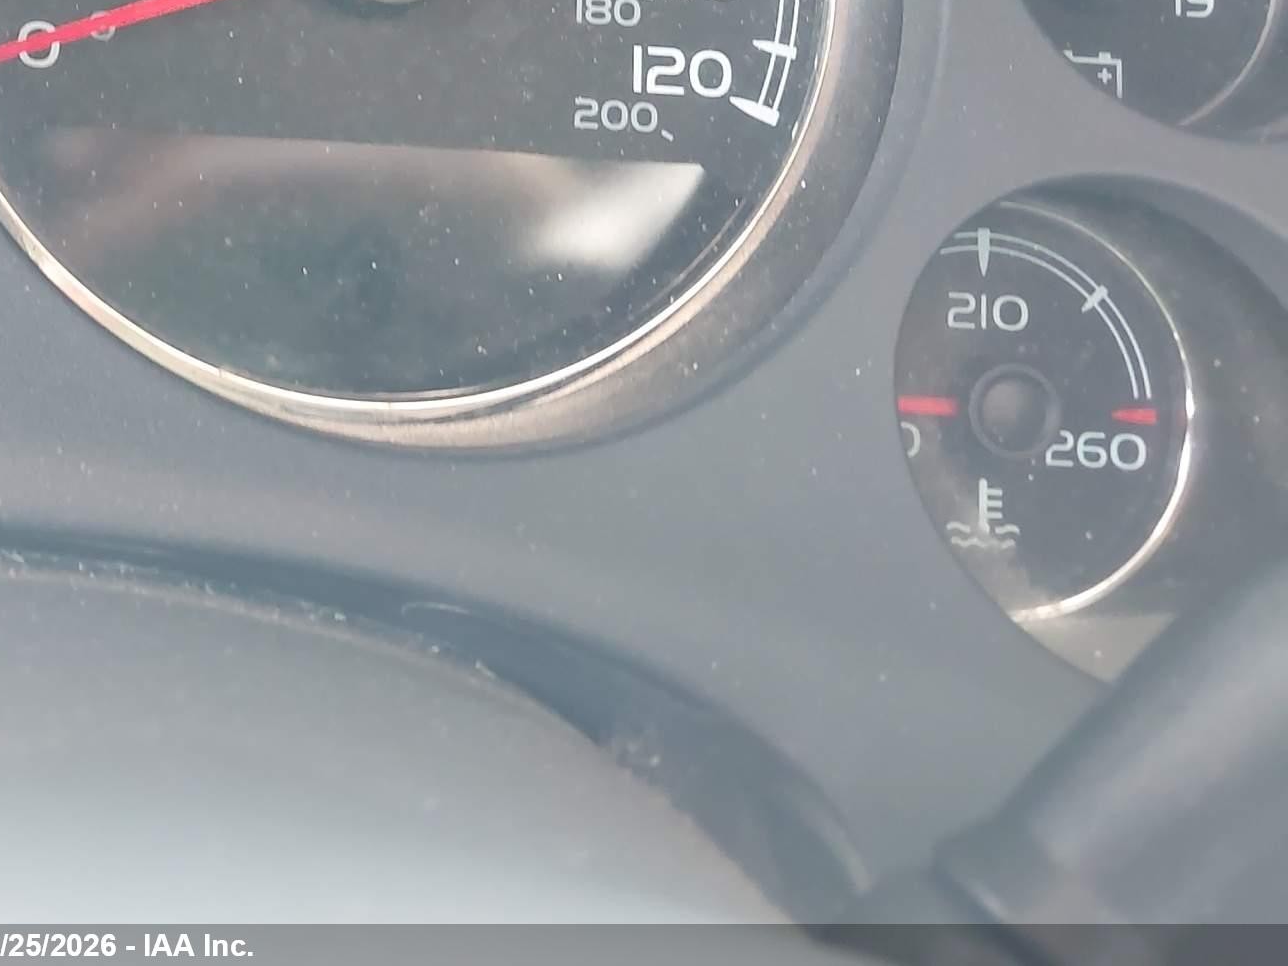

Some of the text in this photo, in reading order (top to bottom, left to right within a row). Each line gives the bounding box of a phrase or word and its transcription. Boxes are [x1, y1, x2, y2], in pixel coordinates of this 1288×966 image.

[17, 20, 61, 69] 0
[632, 45, 732, 98] 120
[574, 95, 658, 133] 200
[946, 292, 1029, 332] 210
[1045, 430, 1147, 471] 260
